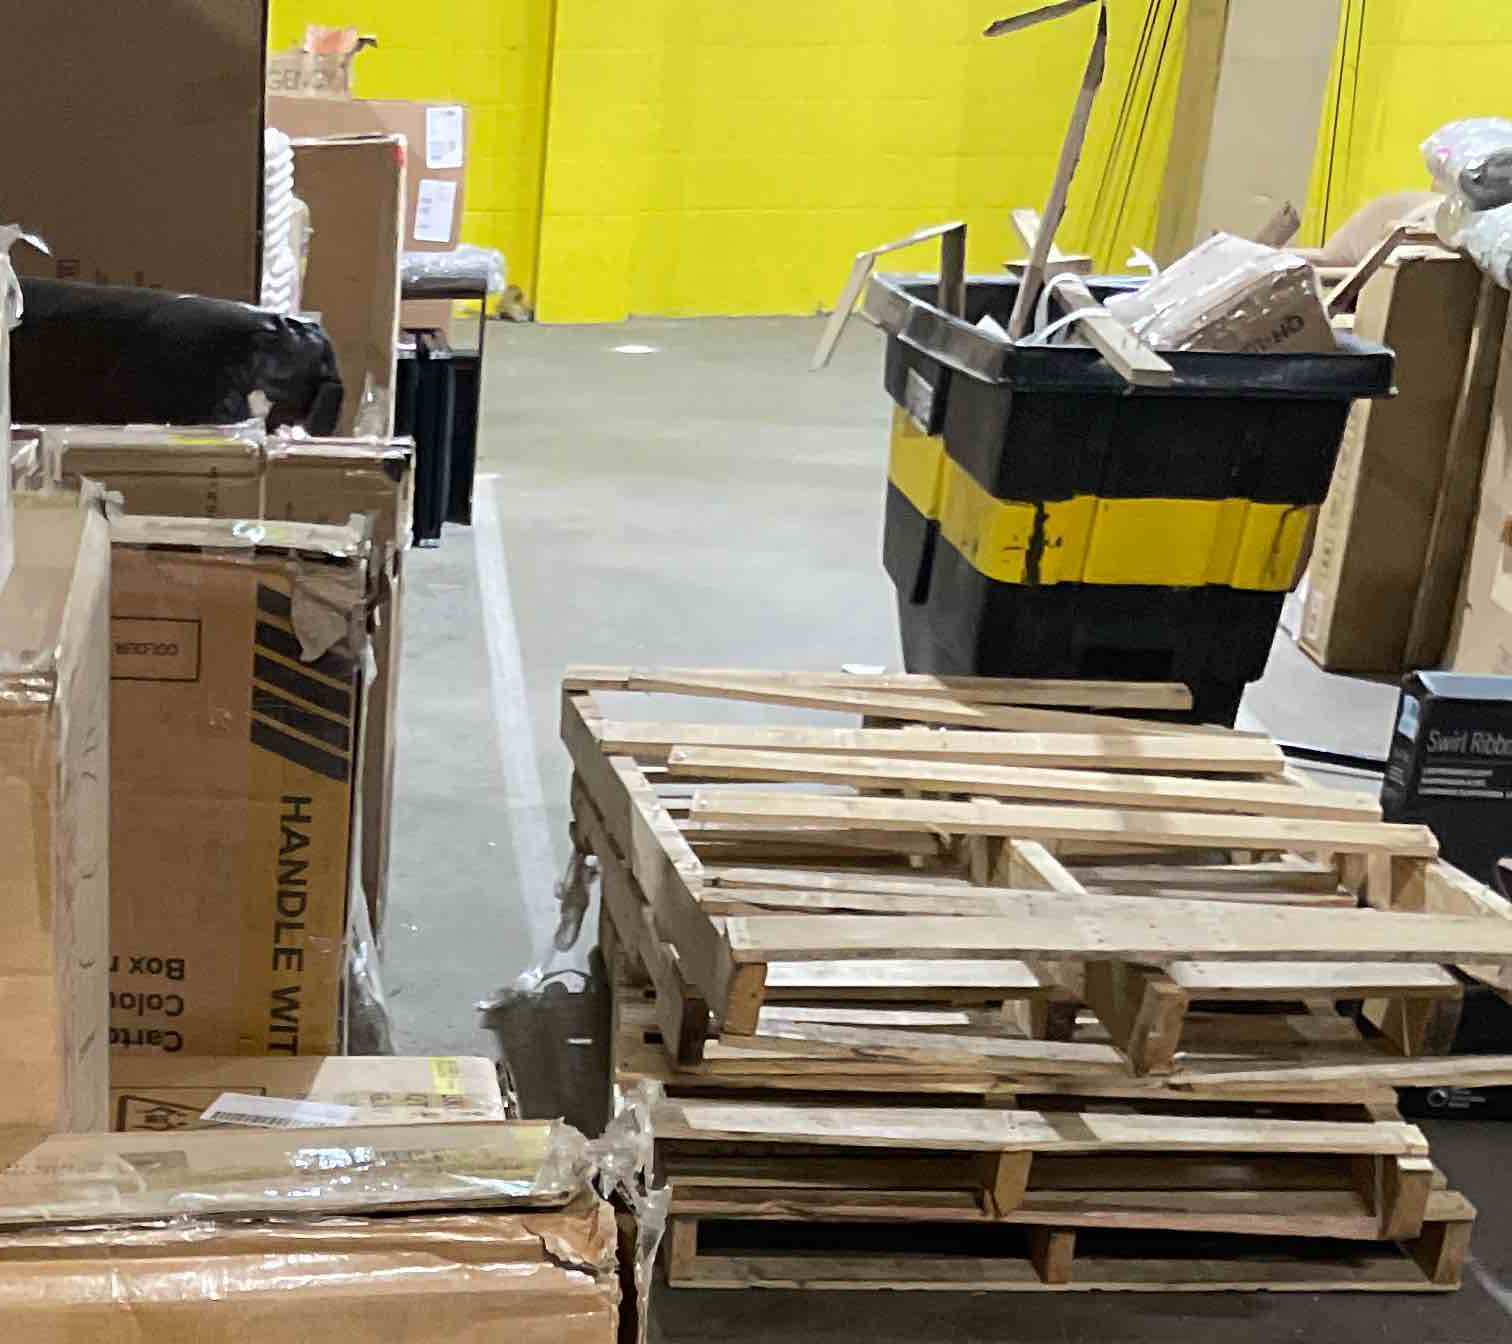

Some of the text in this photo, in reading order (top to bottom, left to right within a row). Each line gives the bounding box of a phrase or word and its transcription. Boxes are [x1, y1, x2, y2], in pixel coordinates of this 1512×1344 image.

[1426, 728, 1467, 753] Swirl
[272, 795, 313, 971] HANDLE
[128, 957, 185, 980] Box
